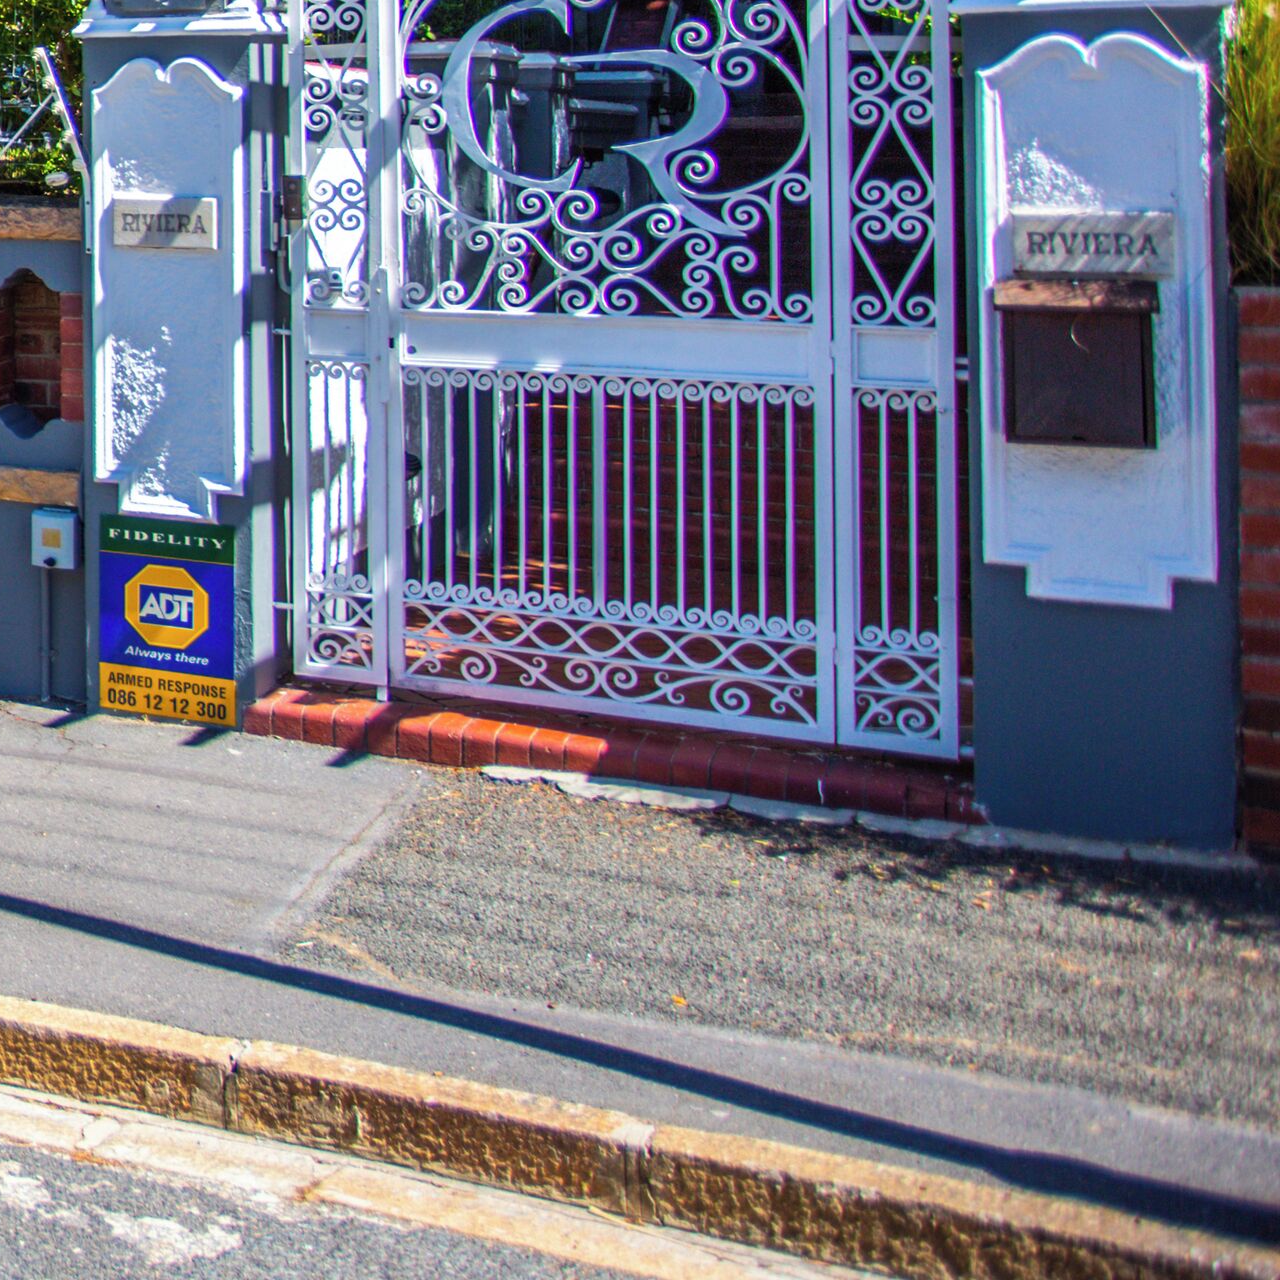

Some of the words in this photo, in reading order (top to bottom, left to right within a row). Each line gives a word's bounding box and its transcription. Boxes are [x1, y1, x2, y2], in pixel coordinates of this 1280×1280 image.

[121, 213, 207, 234] RIVIERA
[1027, 231, 1159, 256] RIVIERA
[108, 527, 226, 550] FIDELITY
[139, 592, 194, 622] ADT
[124, 645, 171, 661] Always
[175, 652, 209, 665] there
[108, 671, 153, 689] ARMED
[158, 678, 226, 699] RESPONSE
[107, 688, 137, 707] 086
[143, 693, 163, 711] 12
[170, 697, 189, 715] 12
[196, 701, 227, 720] 300
